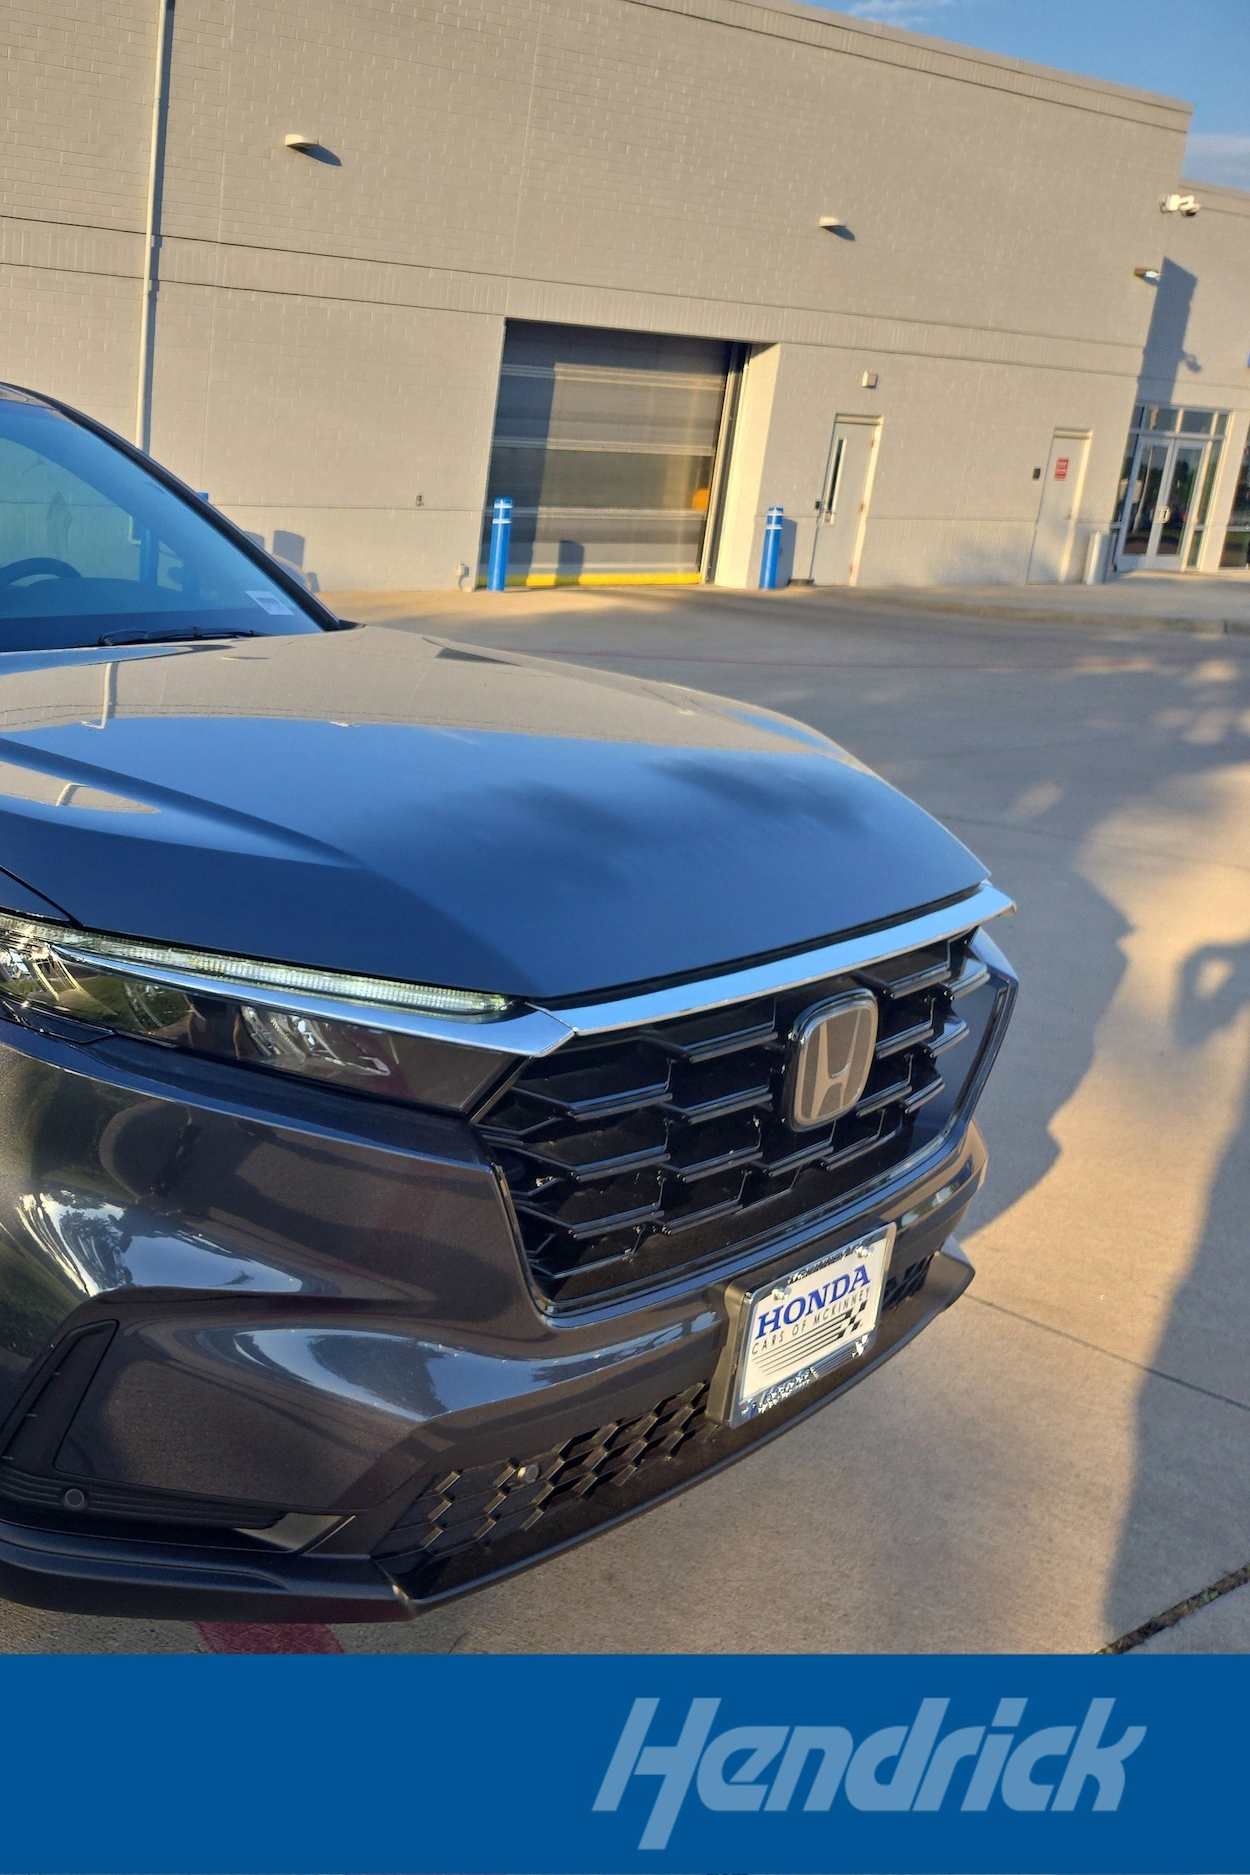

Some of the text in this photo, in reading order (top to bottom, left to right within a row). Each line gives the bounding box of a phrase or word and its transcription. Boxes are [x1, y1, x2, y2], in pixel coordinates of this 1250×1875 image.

[751, 1286, 871, 1355] CARS OF MCKINNEY
[754, 1264, 871, 1340] HONDA
